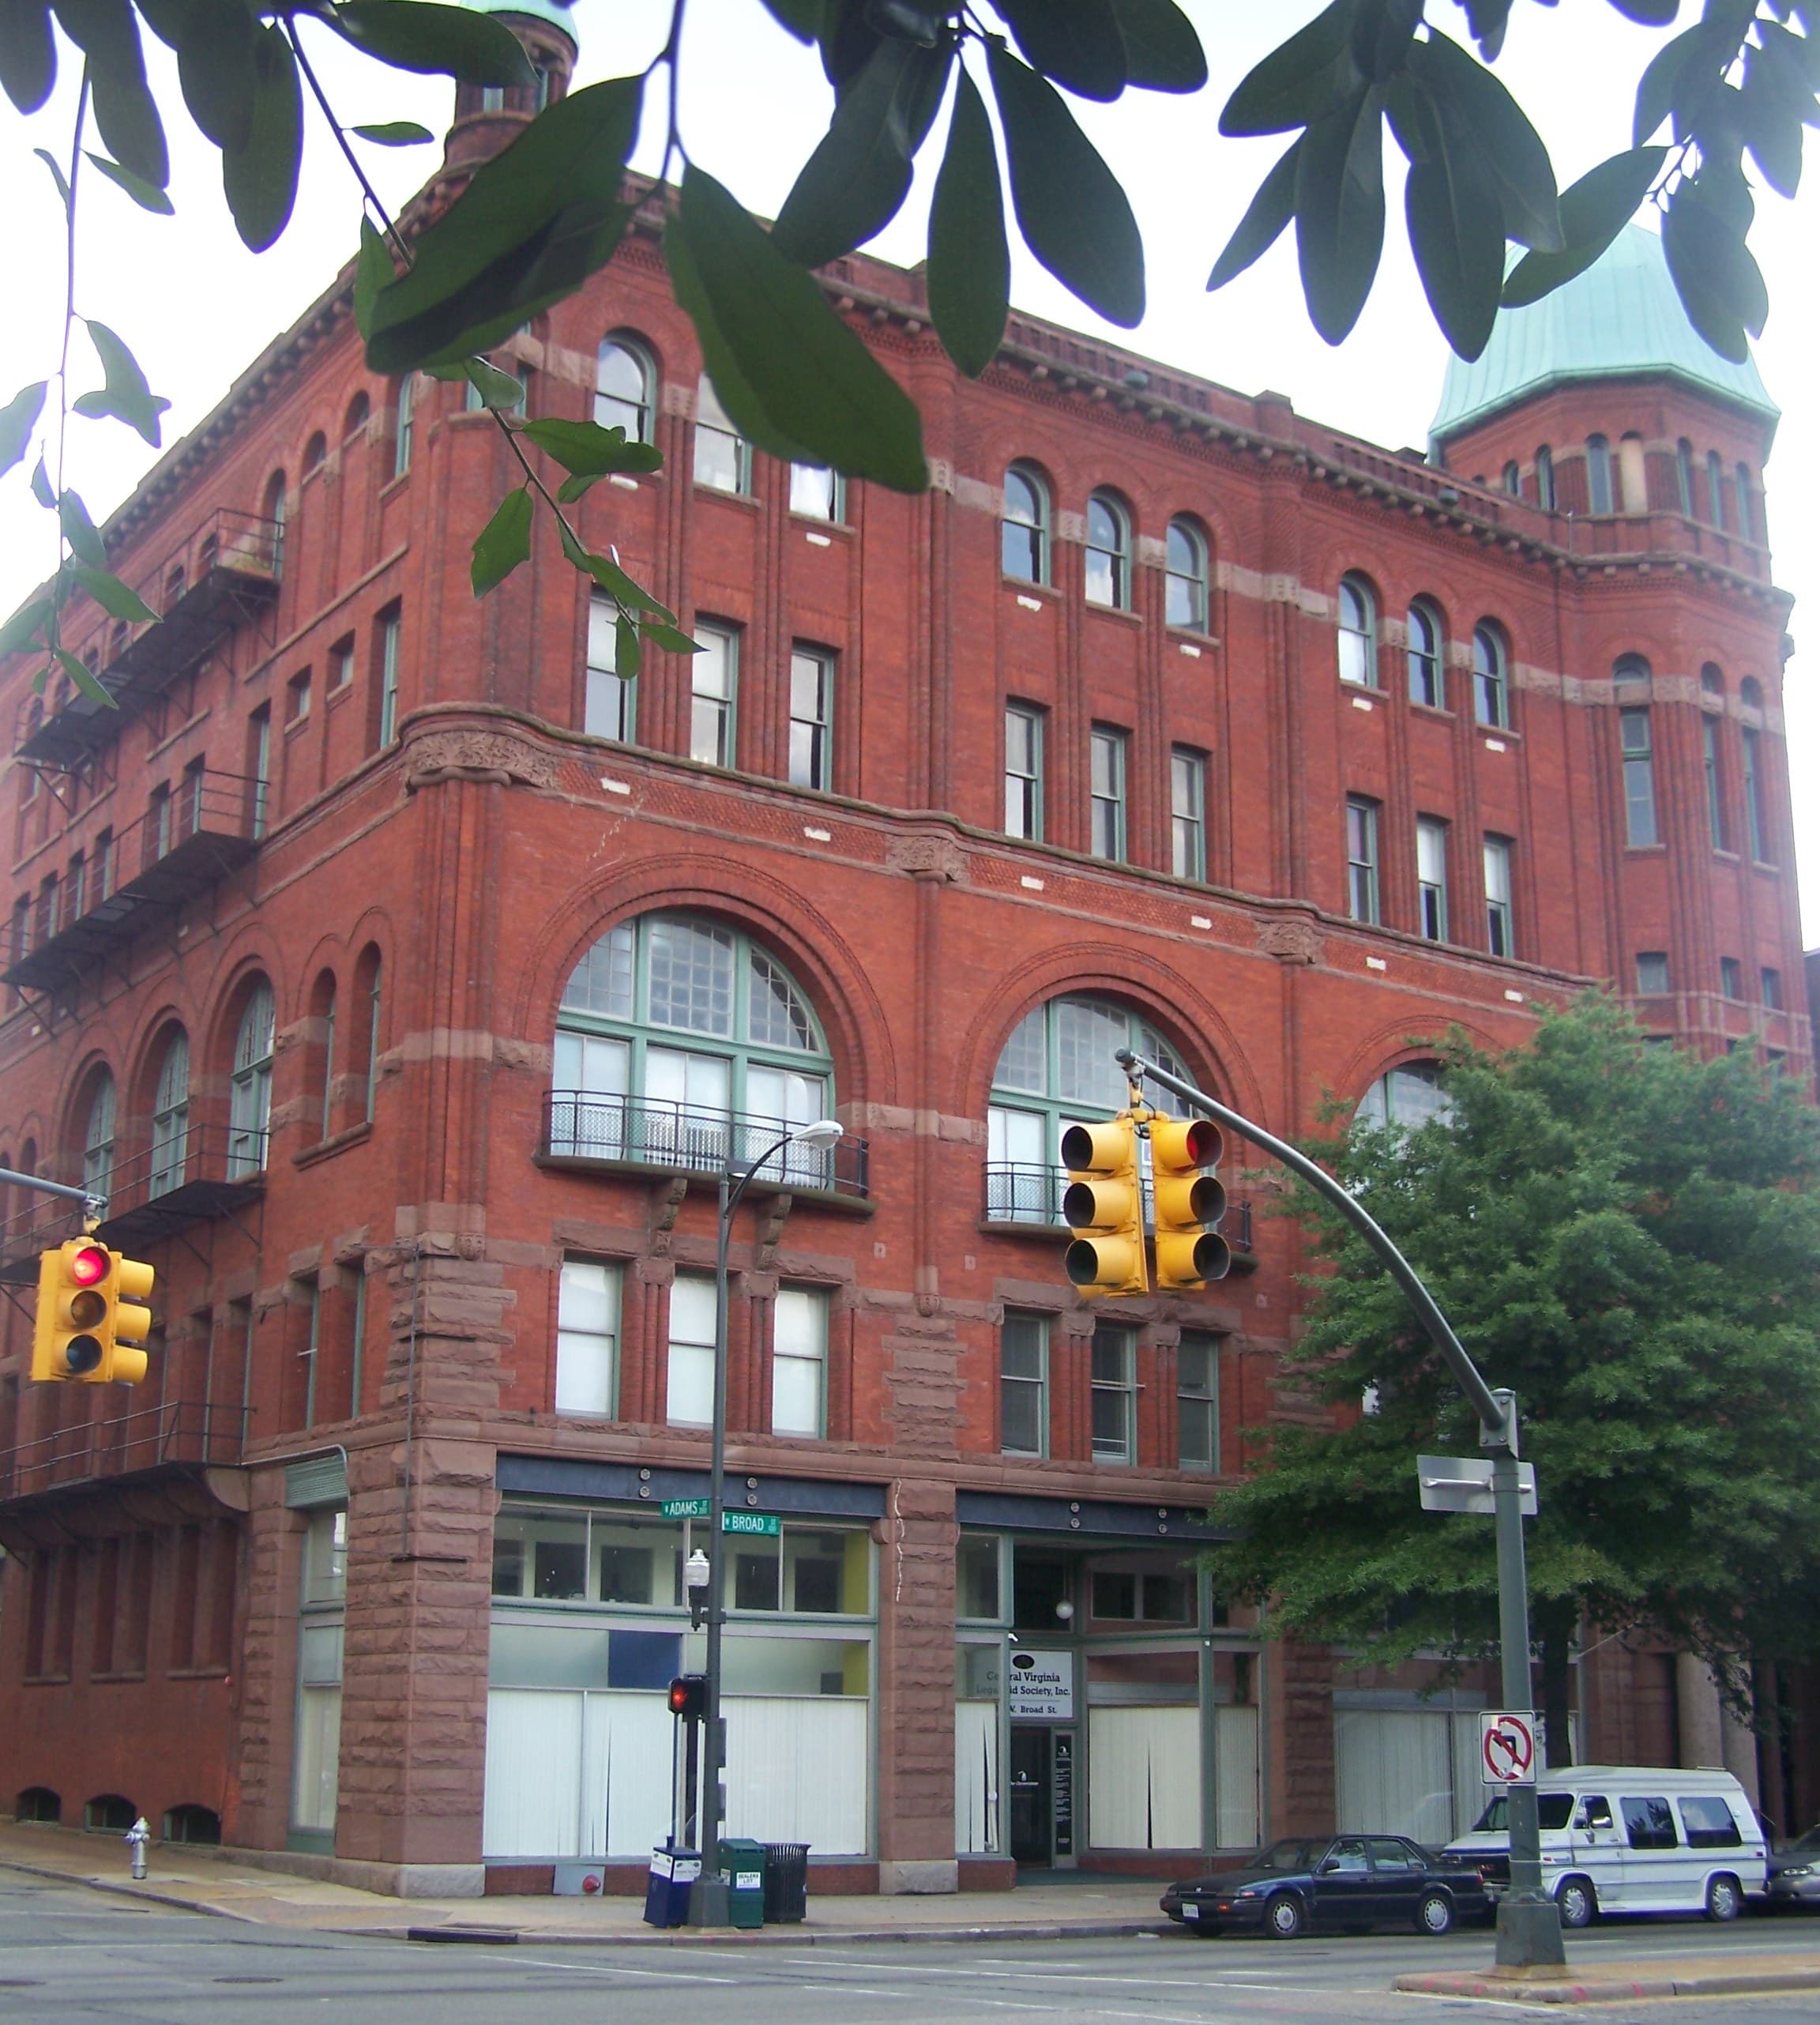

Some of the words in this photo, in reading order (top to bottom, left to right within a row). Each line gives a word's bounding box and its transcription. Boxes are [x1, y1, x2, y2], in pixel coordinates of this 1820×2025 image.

[669, 1501, 698, 1515] ADAMS
[732, 1515, 764, 1530] BROAD
[1024, 1672, 1060, 1684] Virginia
[1021, 1685, 1053, 1696] Society,
[1055, 1686, 1071, 1696] Inc.
